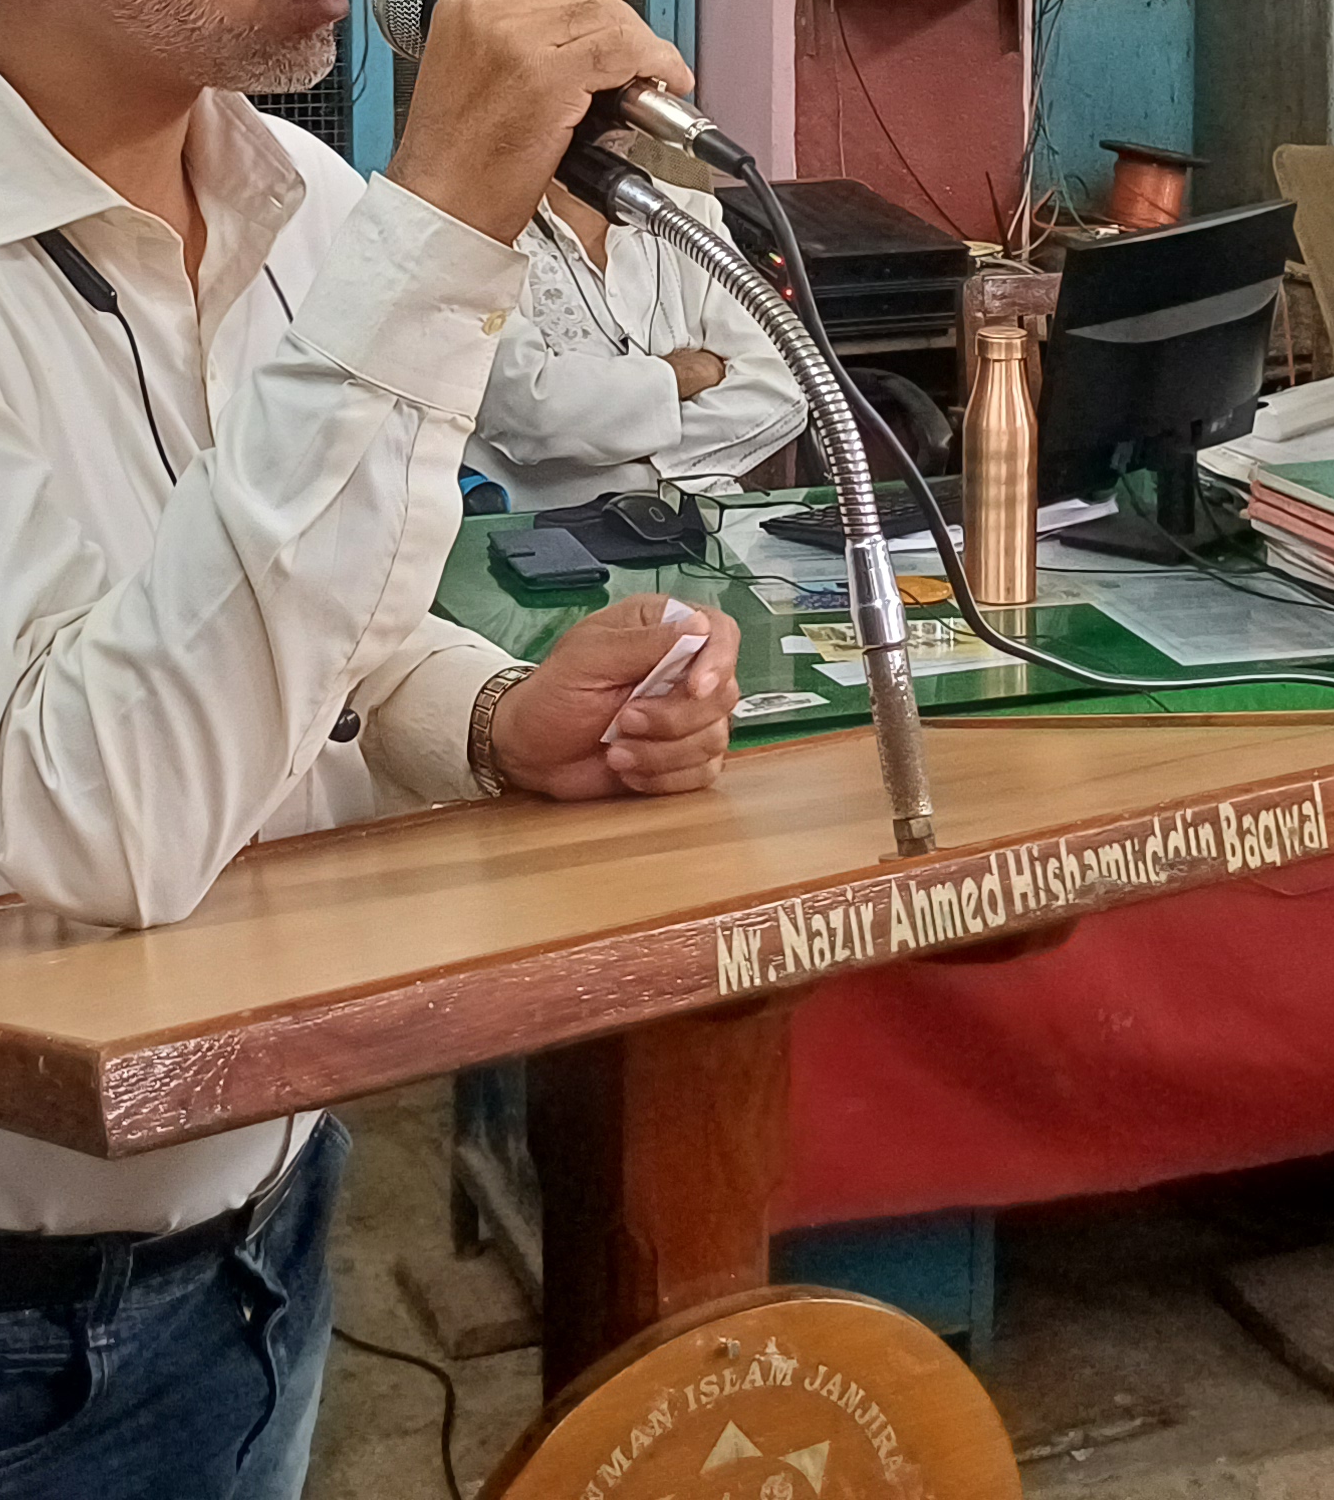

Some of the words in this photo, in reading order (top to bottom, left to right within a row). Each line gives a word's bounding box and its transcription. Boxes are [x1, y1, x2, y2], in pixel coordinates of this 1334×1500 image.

[716, 924, 777, 996] Mr.
[777, 886, 875, 973] Nazir
[889, 851, 1007, 953] Ahmed
[1006, 809, 1218, 915] Hishamuddin
[683, 1356, 799, 1413] ISLAM
[804, 1363, 905, 1481] JANJIRA
